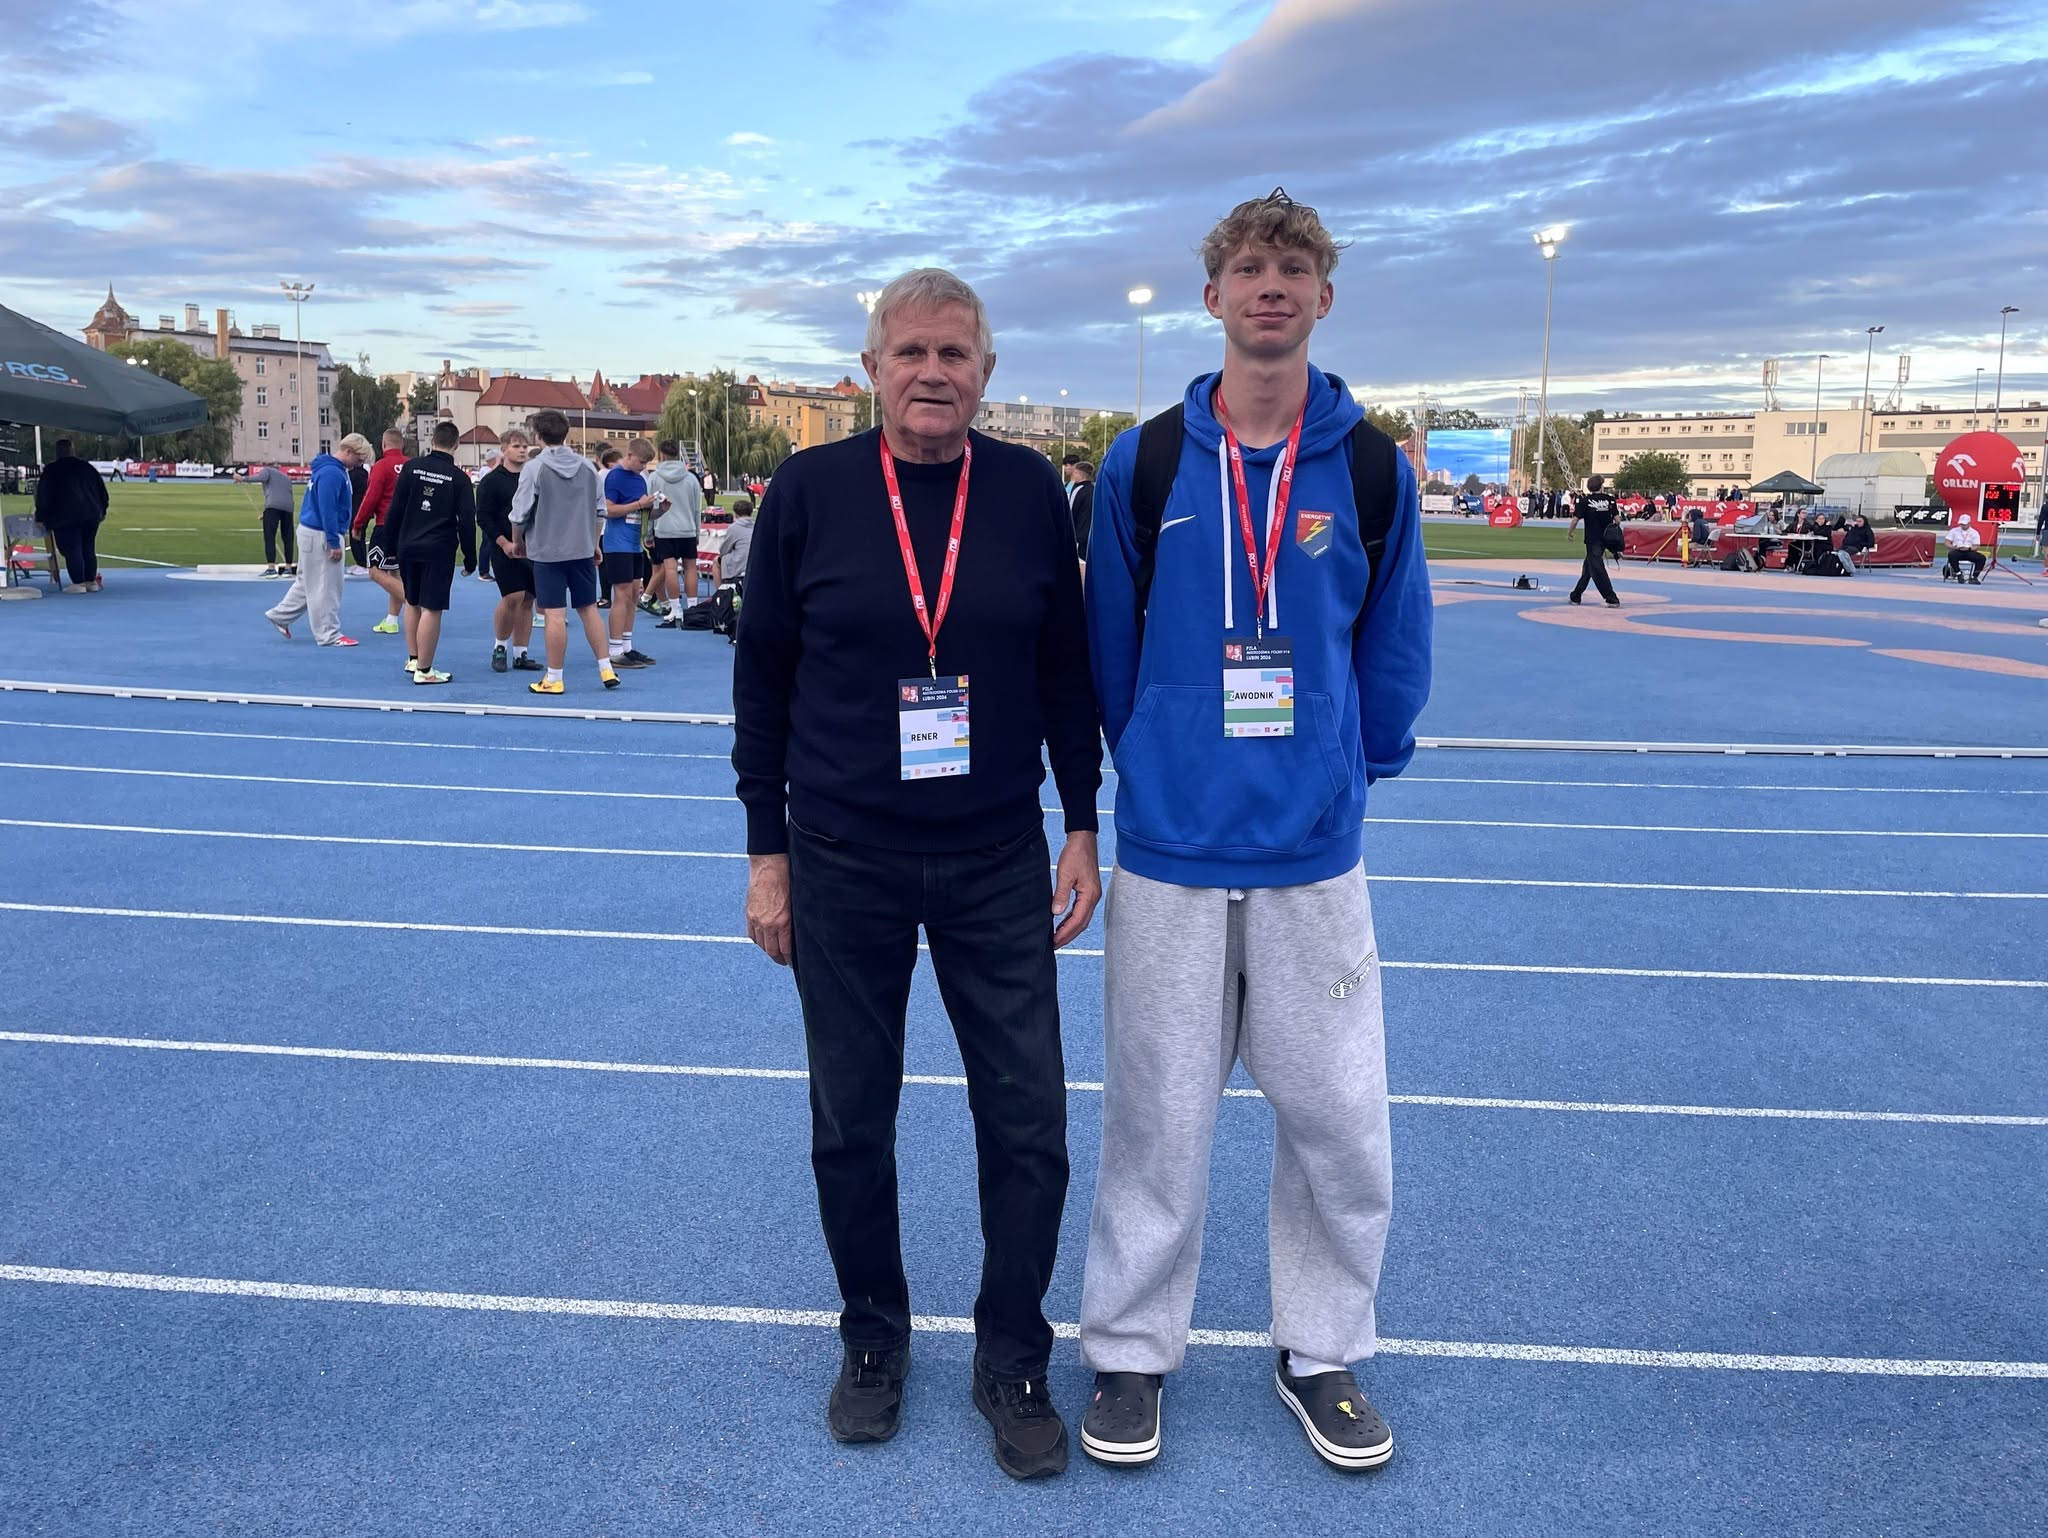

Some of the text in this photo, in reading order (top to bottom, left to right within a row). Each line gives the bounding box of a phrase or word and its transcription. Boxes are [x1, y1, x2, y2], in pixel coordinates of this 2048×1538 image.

[1283, 465, 1292, 482] RCU
[1943, 479, 1978, 488] ORLEN
[1913, 510, 1929, 519] 4F
[1931, 511, 1947, 520] 4F
[1247, 552, 1257, 568] RCU
[914, 594, 925, 609] RCU
